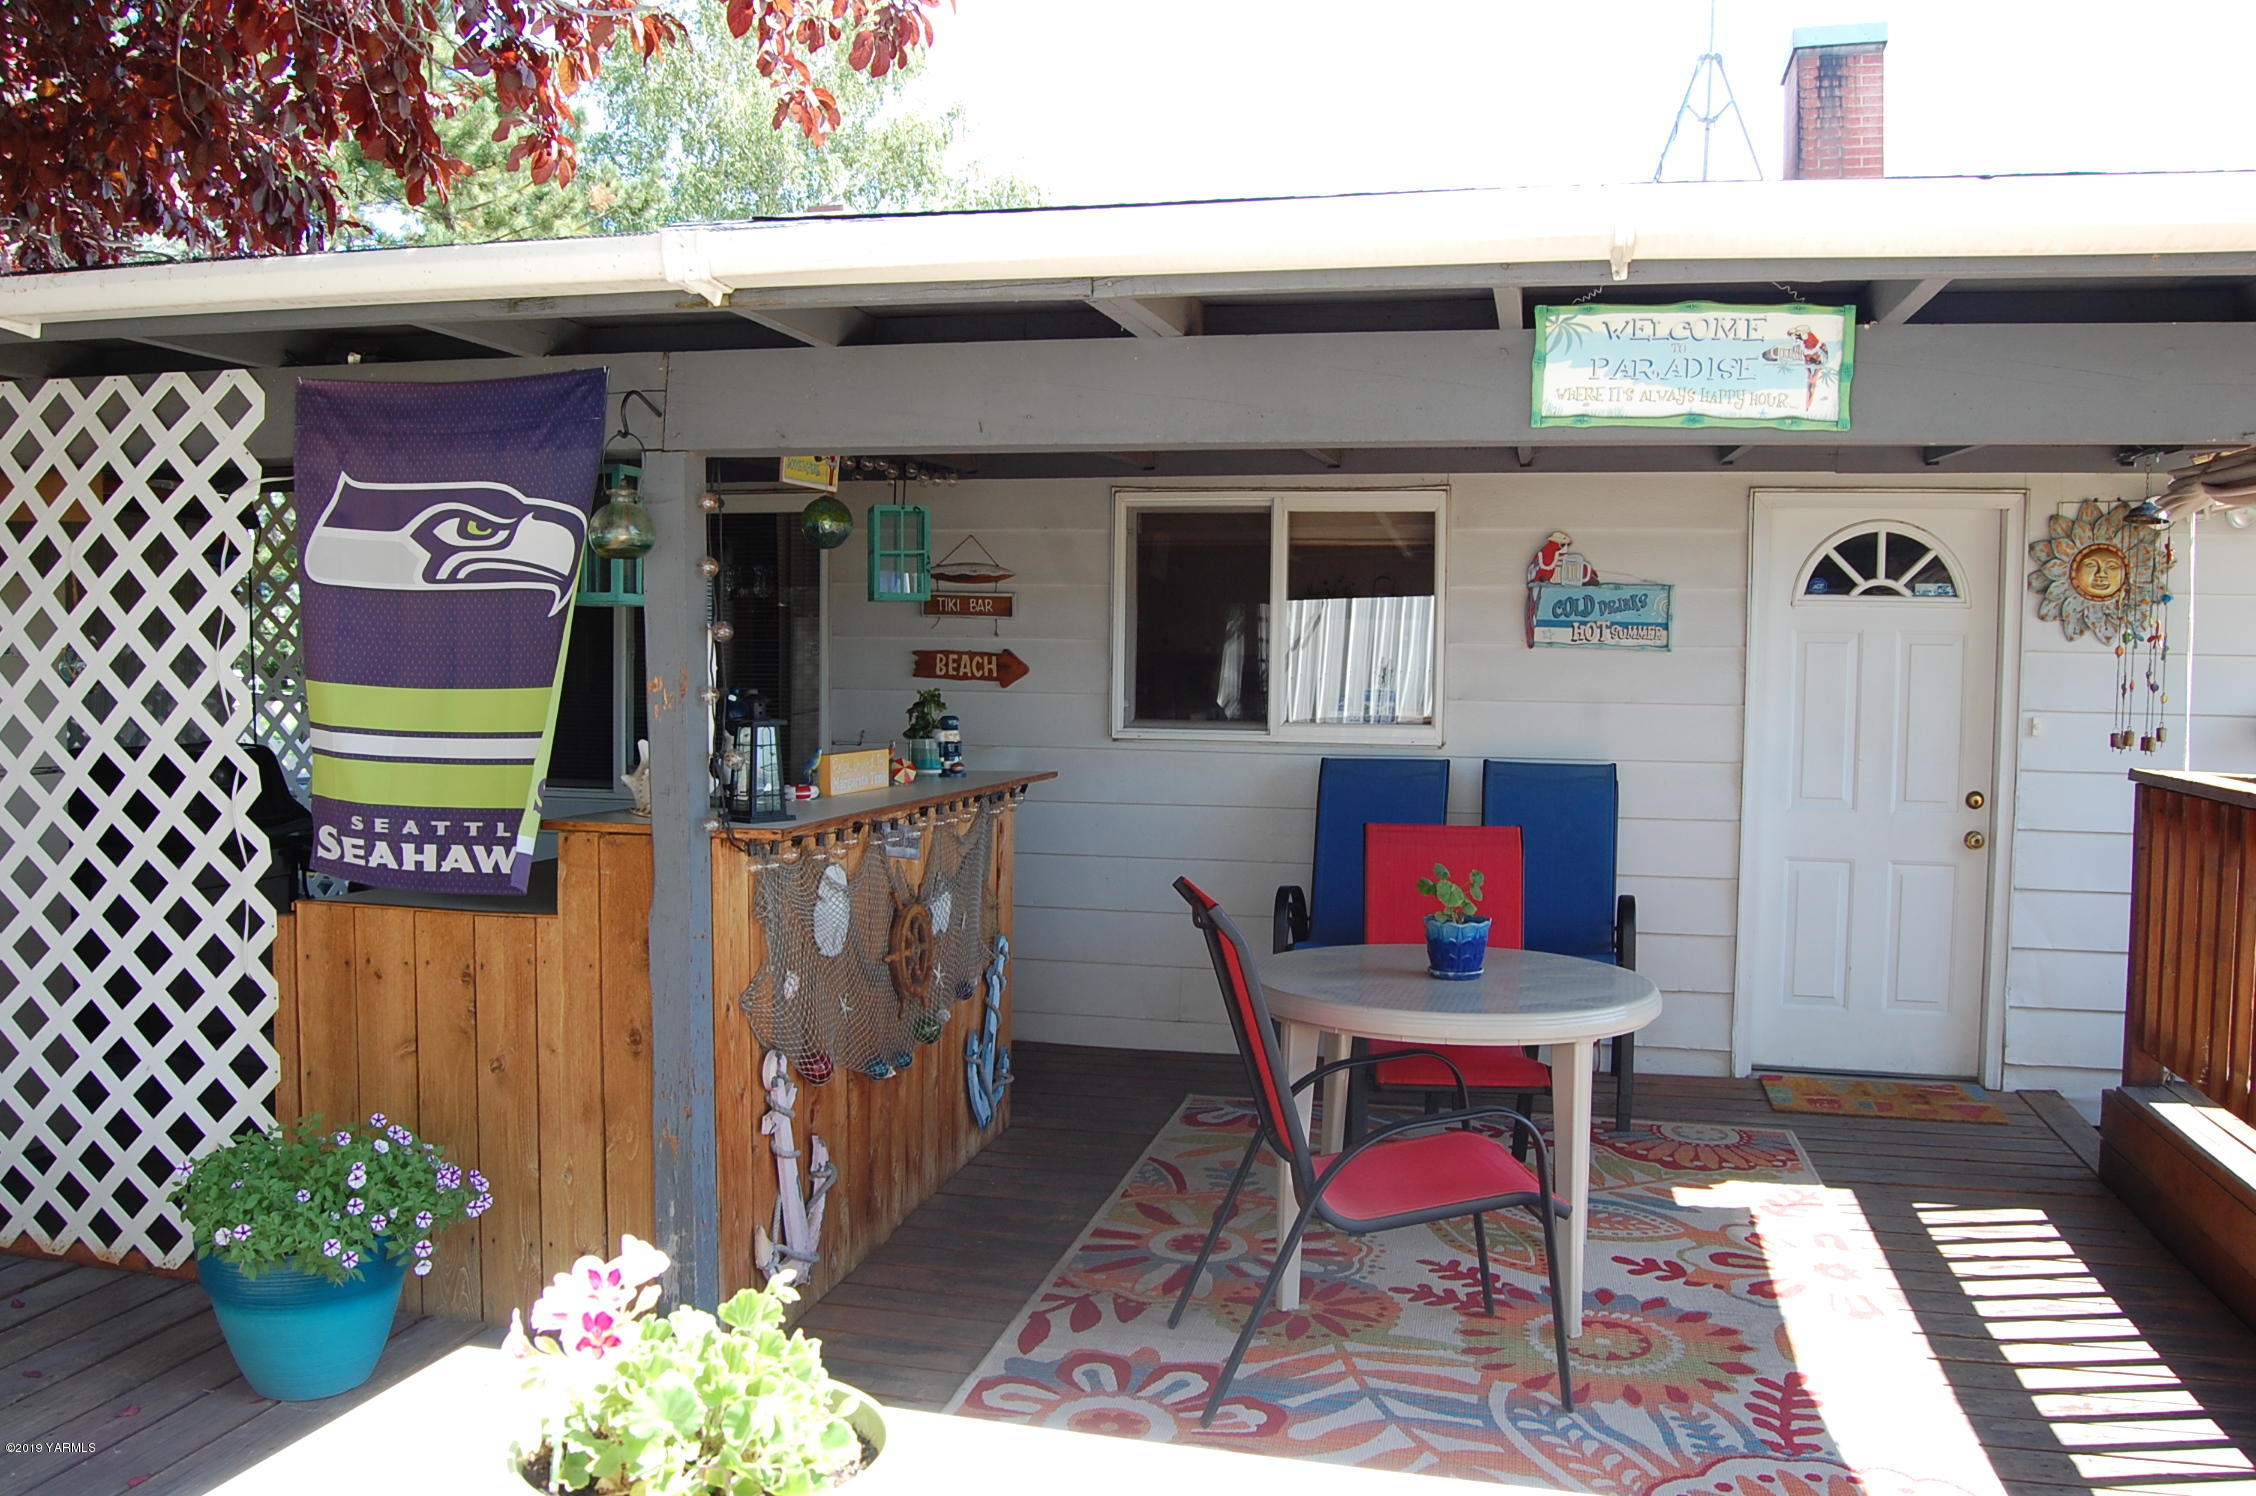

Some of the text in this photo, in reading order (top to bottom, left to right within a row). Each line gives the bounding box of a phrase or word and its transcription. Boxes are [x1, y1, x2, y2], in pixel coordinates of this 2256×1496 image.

[1602, 317, 1768, 342] WELCOME
[1671, 342, 1688, 354] TO
[1588, 357, 1759, 381] PARADISE
[1556, 386, 1605, 402] WHERE
[1608, 386, 1635, 402] IT'S
[1639, 387, 1697, 406] ALWAYS
[1700, 387, 1746, 410] HAPPY
[937, 598, 993, 613] TIKI BAR
[1552, 593, 1648, 619] COLD DRINKS
[1571, 620, 1663, 643] HOT SUMMER
[936, 653, 998, 678] BEACH
[351, 815, 512, 837] SEATTL
[317, 824, 517, 875] SEAHAW
